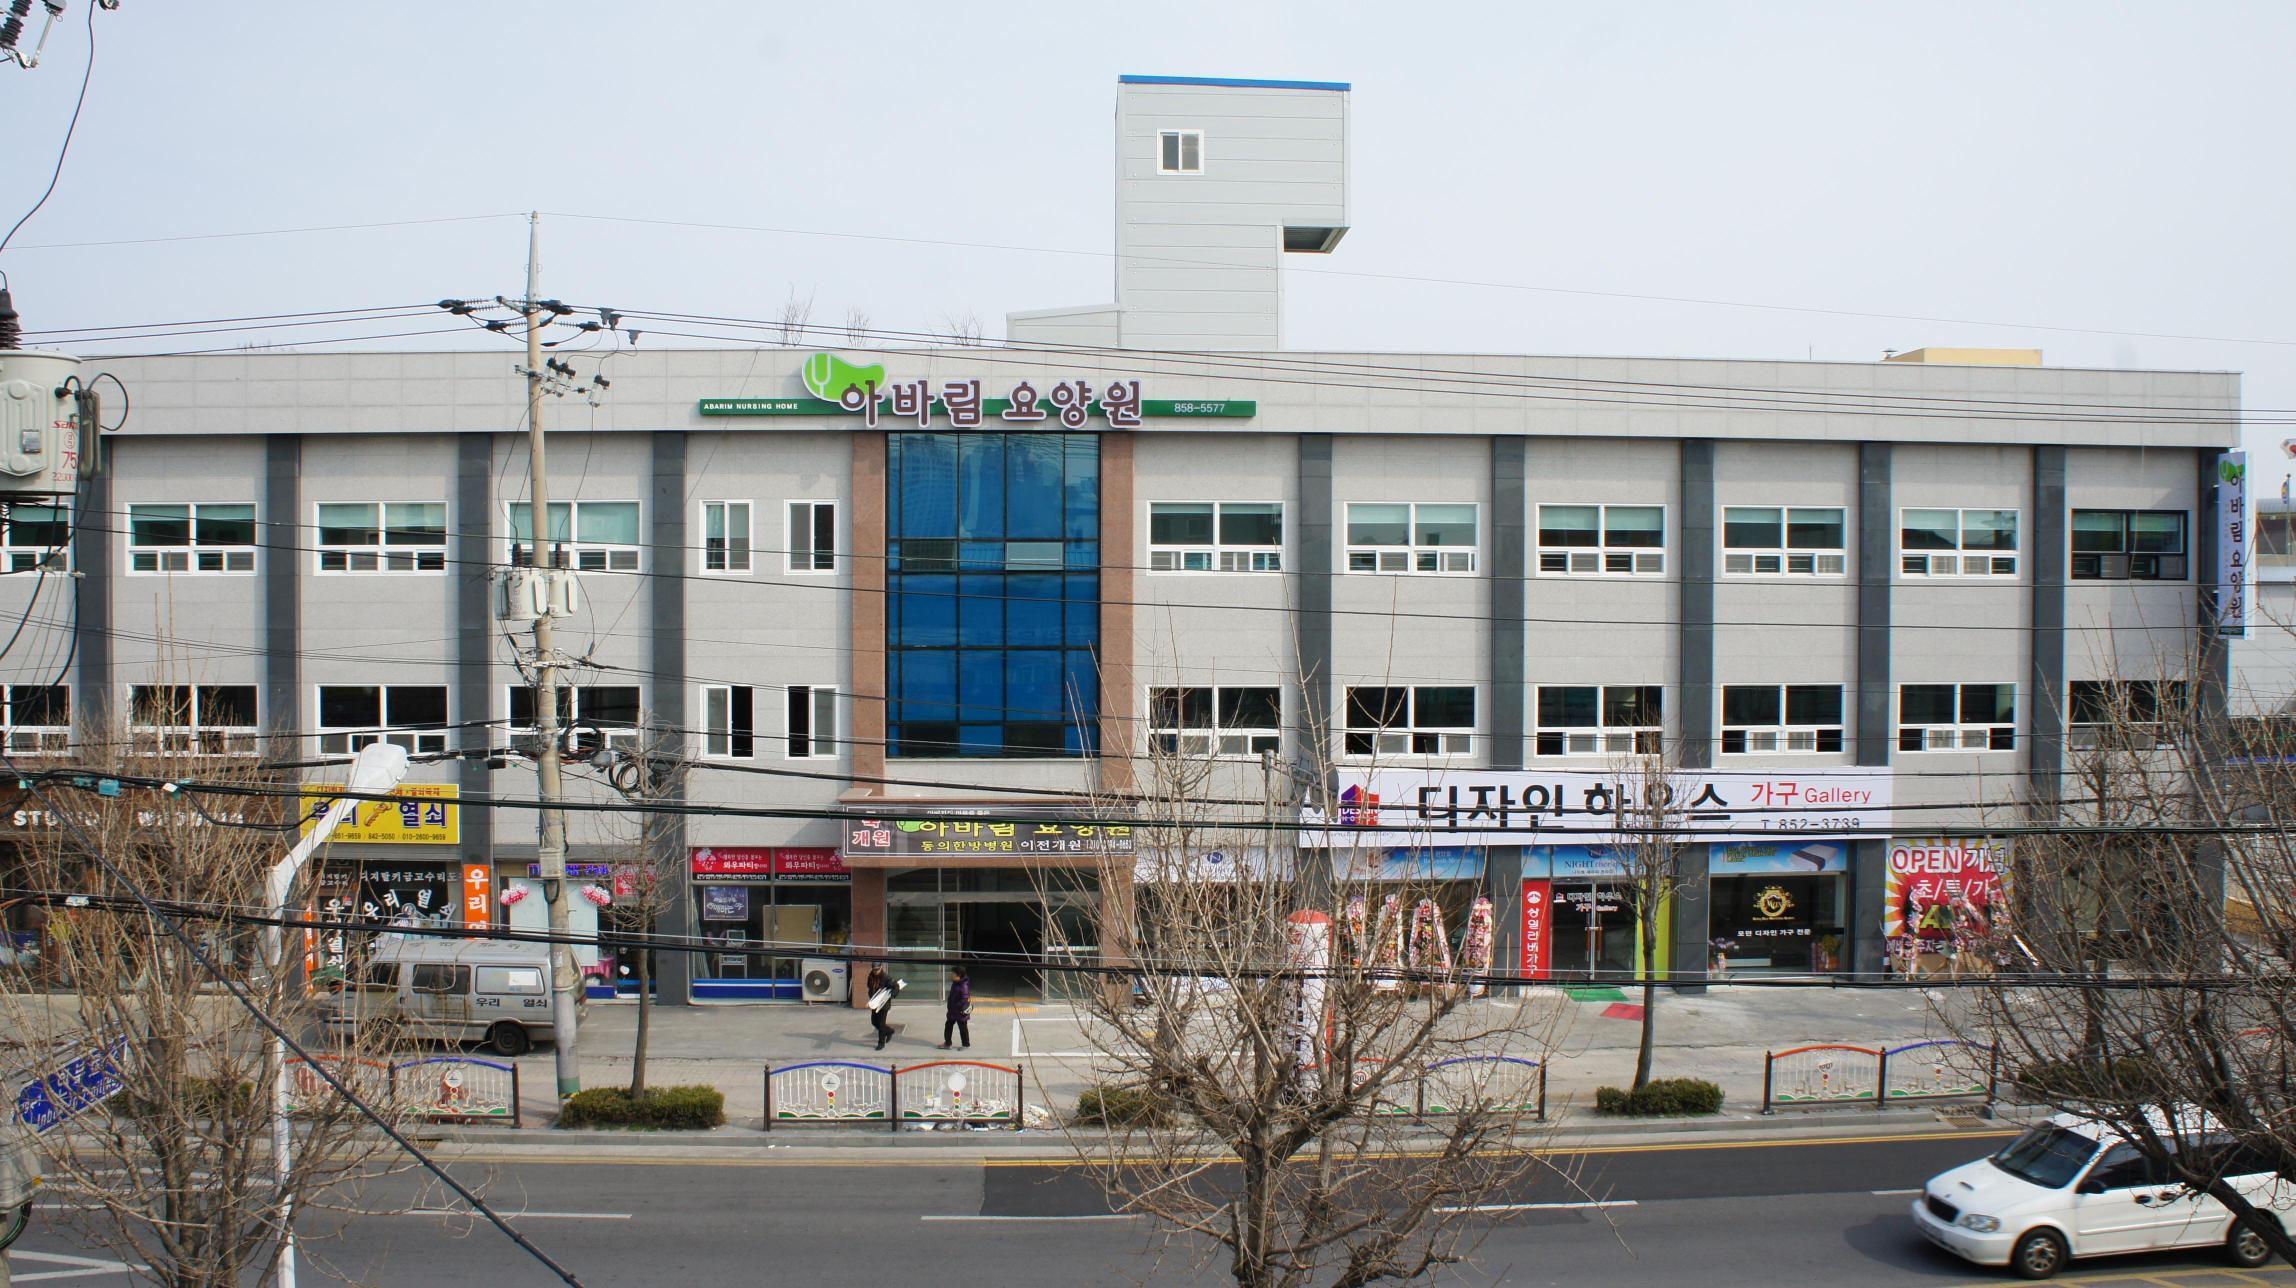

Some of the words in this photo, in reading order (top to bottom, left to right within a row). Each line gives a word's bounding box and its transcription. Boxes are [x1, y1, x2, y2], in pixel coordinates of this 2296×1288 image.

[840, 379, 984, 429] 아바림
[1002, 379, 1143, 429] 요양원
[1174, 402, 1225, 414] 858-5577
[2230, 473, 2244, 543] 아바림
[1751, 781, 1799, 806] 가구
[1804, 787, 1872, 805] Gallery
[400, 799, 447, 828] 열쇠
[1418, 784, 1564, 834] 디자인
[1584, 783, 1730, 830] 하우스
[1778, 818, 1861, 831] 852-3739
[852, 830, 890, 847] 개원
[920, 839, 1014, 852] 동의한방병원
[1020, 839, 1081, 851] 이전개원
[1890, 846, 1962, 873] OPEN
[1755, 929, 1777, 937] 디자인
[1797, 928, 1811, 936] 전문
[475, 997, 500, 1007] 우리
[523, 997, 547, 1008] 열쇠
